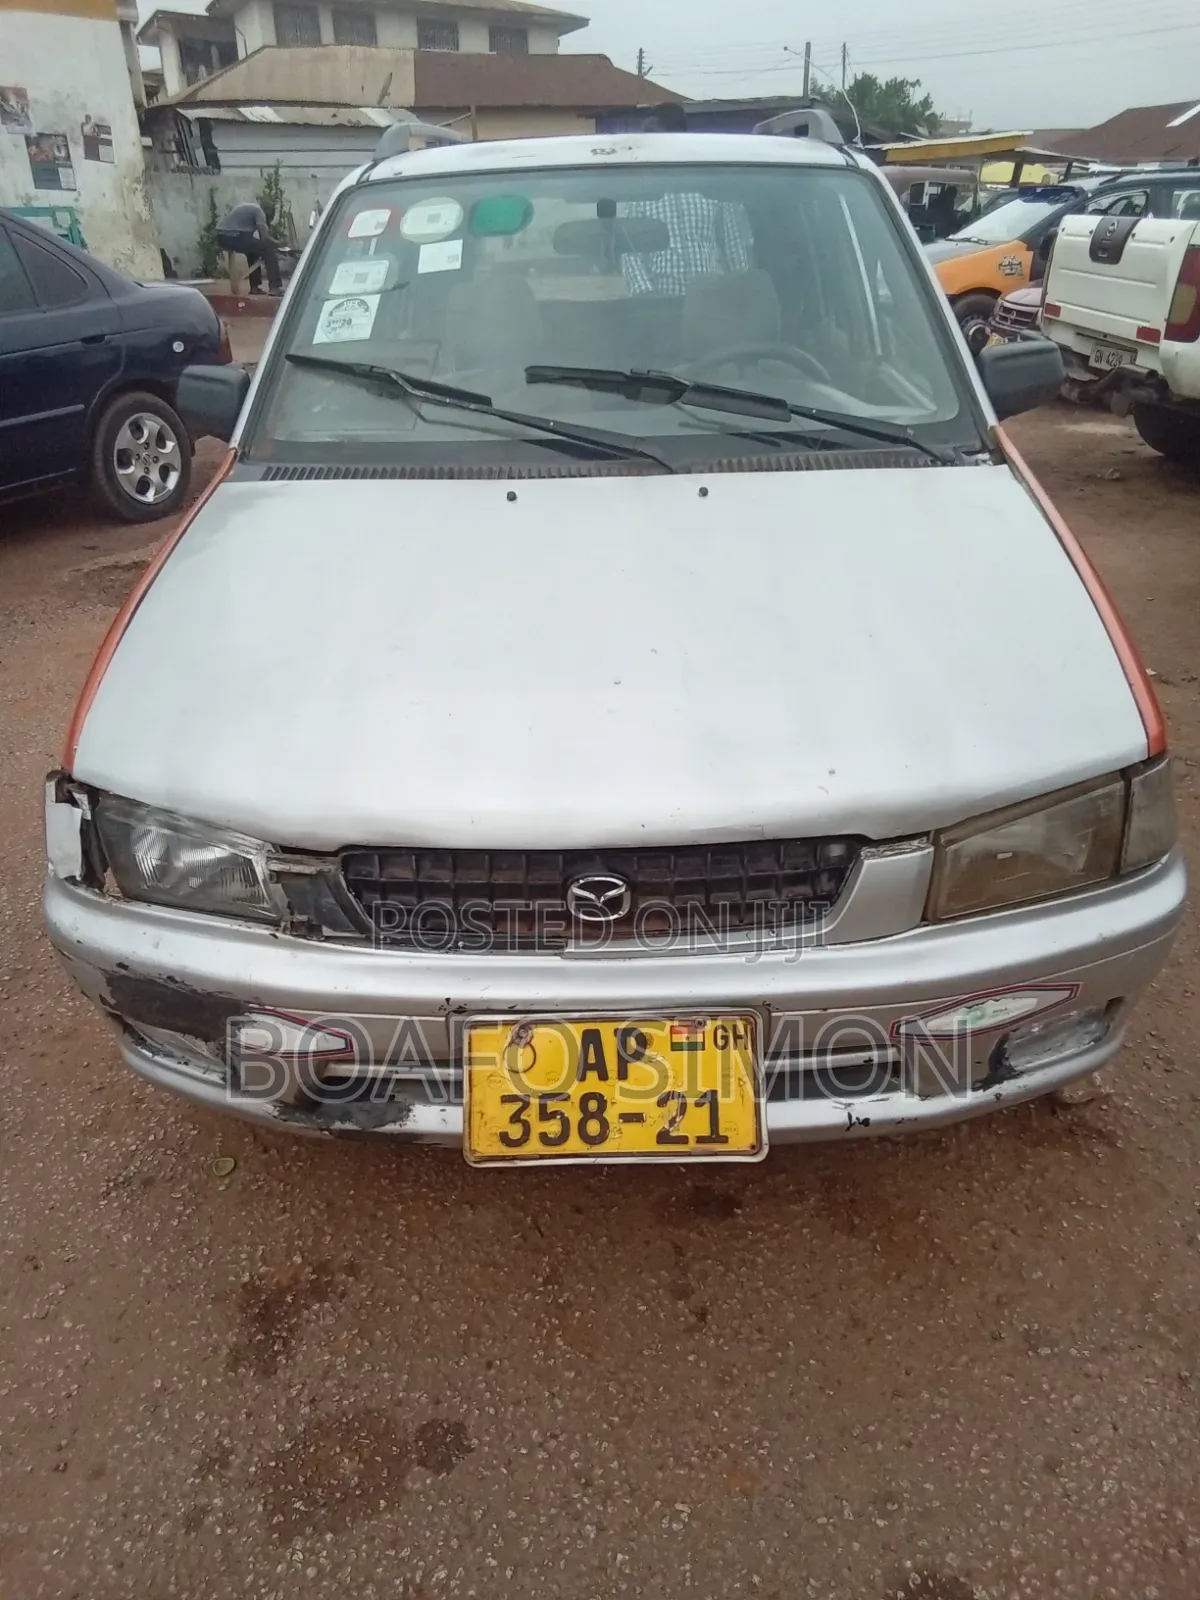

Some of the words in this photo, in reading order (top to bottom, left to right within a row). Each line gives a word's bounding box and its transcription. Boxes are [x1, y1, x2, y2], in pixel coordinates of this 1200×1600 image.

[578, 1027, 647, 1082] AP
[713, 1025, 750, 1051] GH
[499, 1090, 729, 1148] 358-21
